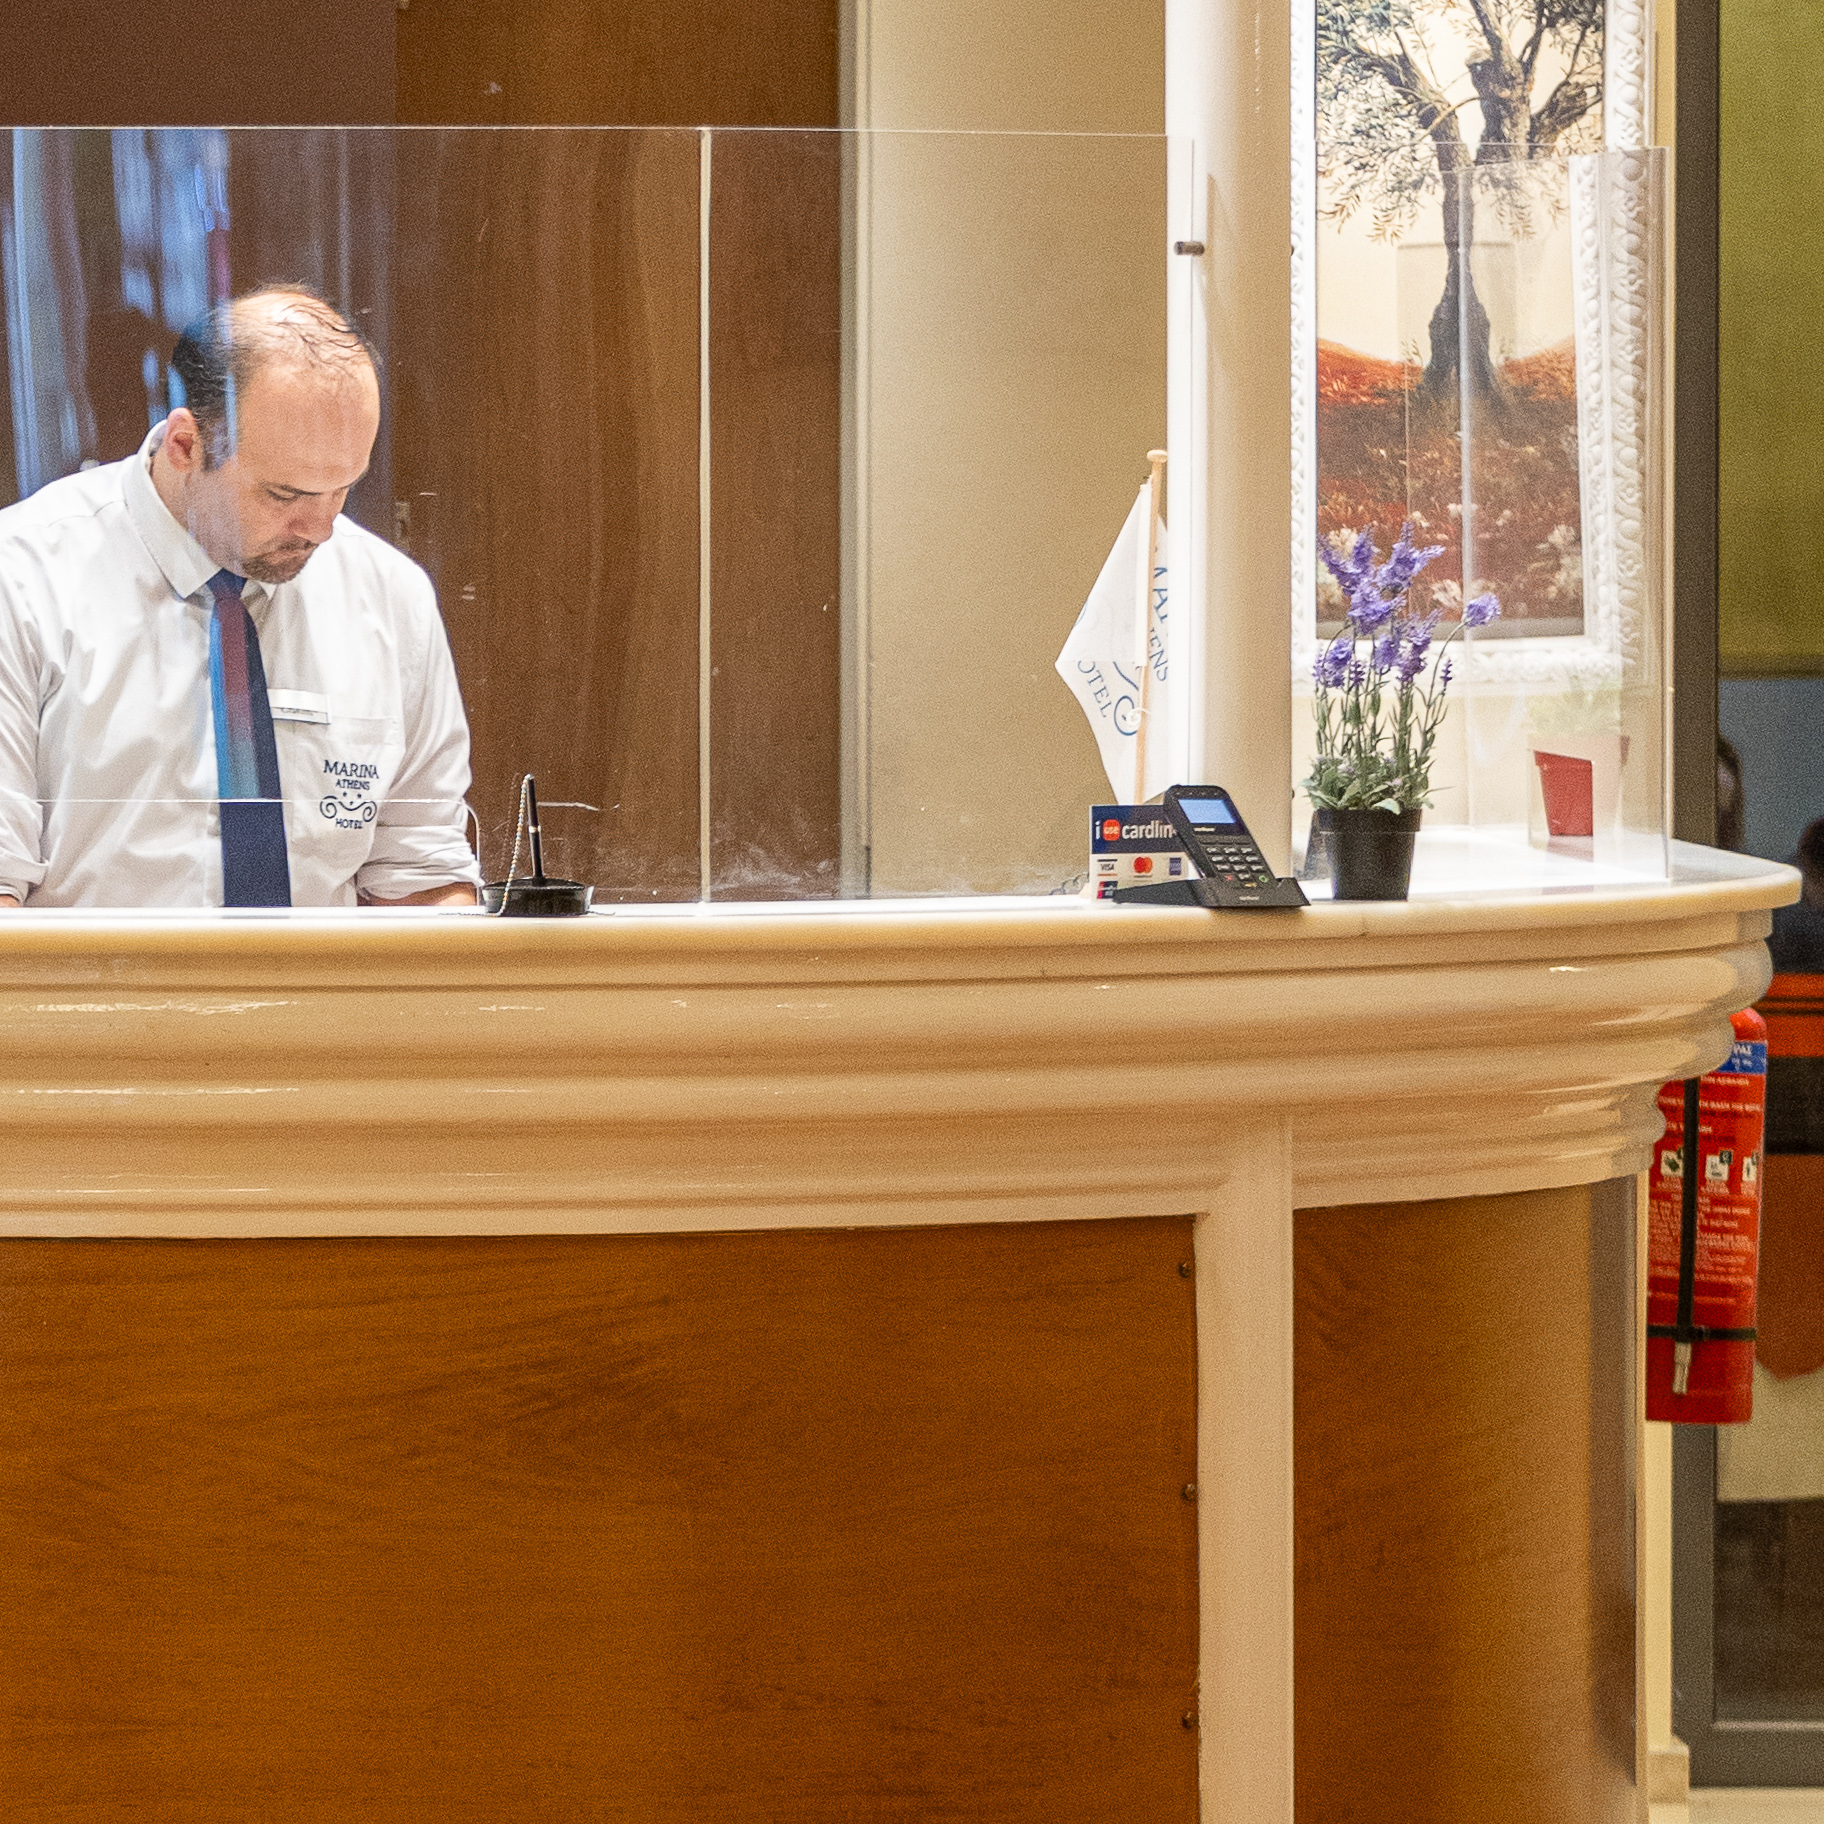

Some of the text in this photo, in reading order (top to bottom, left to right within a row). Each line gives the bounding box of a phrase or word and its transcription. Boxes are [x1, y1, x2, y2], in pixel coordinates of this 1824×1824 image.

[1078, 660, 1112, 718] OTEL
[323, 759, 380, 779] MARINA
[335, 778, 371, 791] ATHENS
[335, 818, 363, 830] HOTEL
[1095, 820, 1101, 840] i
[1122, 820, 1177, 839] cardlin
[1101, 863, 1115, 871] VISA
